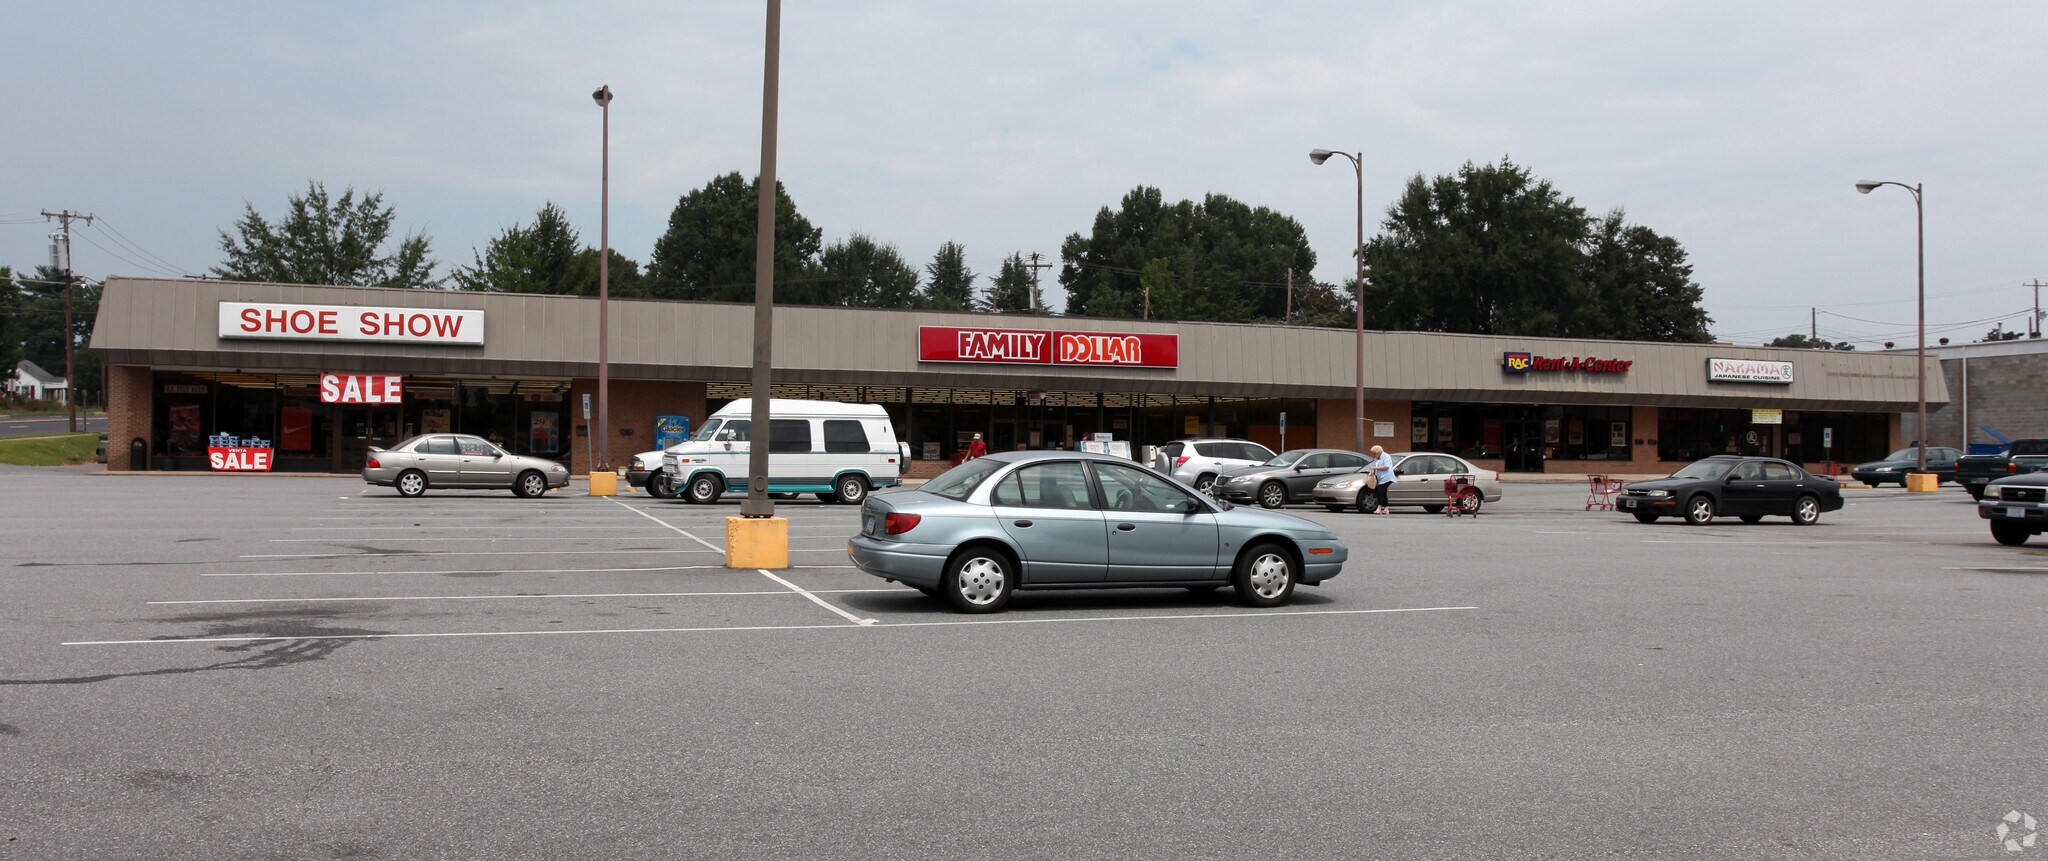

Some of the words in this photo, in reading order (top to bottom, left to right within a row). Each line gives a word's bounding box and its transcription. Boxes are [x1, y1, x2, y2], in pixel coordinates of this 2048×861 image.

[240, 308, 339, 334] SHOE
[359, 311, 463, 338] SHOW
[958, 331, 1045, 360] FAMILY
[1060, 334, 1141, 363] DOLLAR
[1508, 357, 1528, 369] RAC
[1714, 361, 1780, 375] NAKAMA
[322, 375, 401, 402] SALE
[211, 452, 268, 469] SALE
